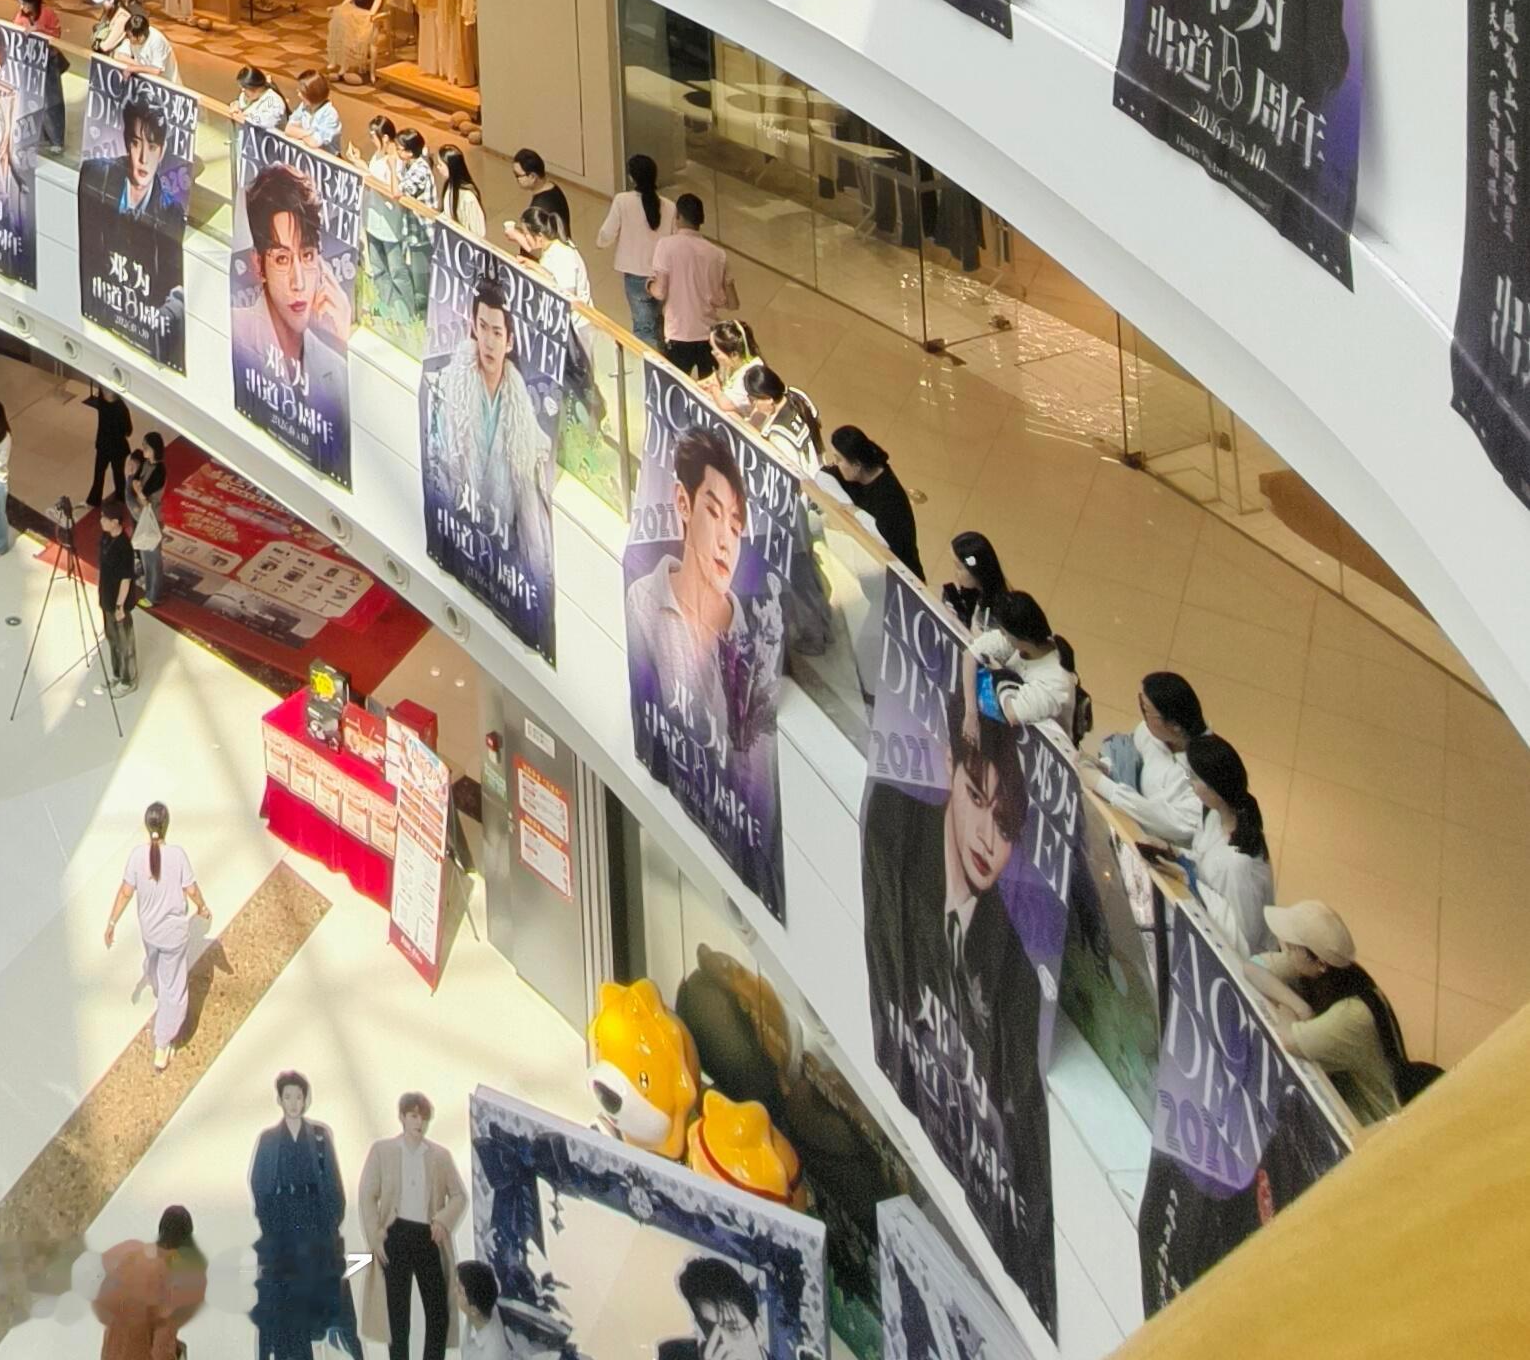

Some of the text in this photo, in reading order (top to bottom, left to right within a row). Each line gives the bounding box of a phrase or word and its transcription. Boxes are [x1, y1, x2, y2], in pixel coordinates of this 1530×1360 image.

[108, 251, 151, 297] 邓为
[265, 345, 309, 396] 邓为
[455, 482, 509, 552] 邓为
[669, 678, 728, 770] 邓为
